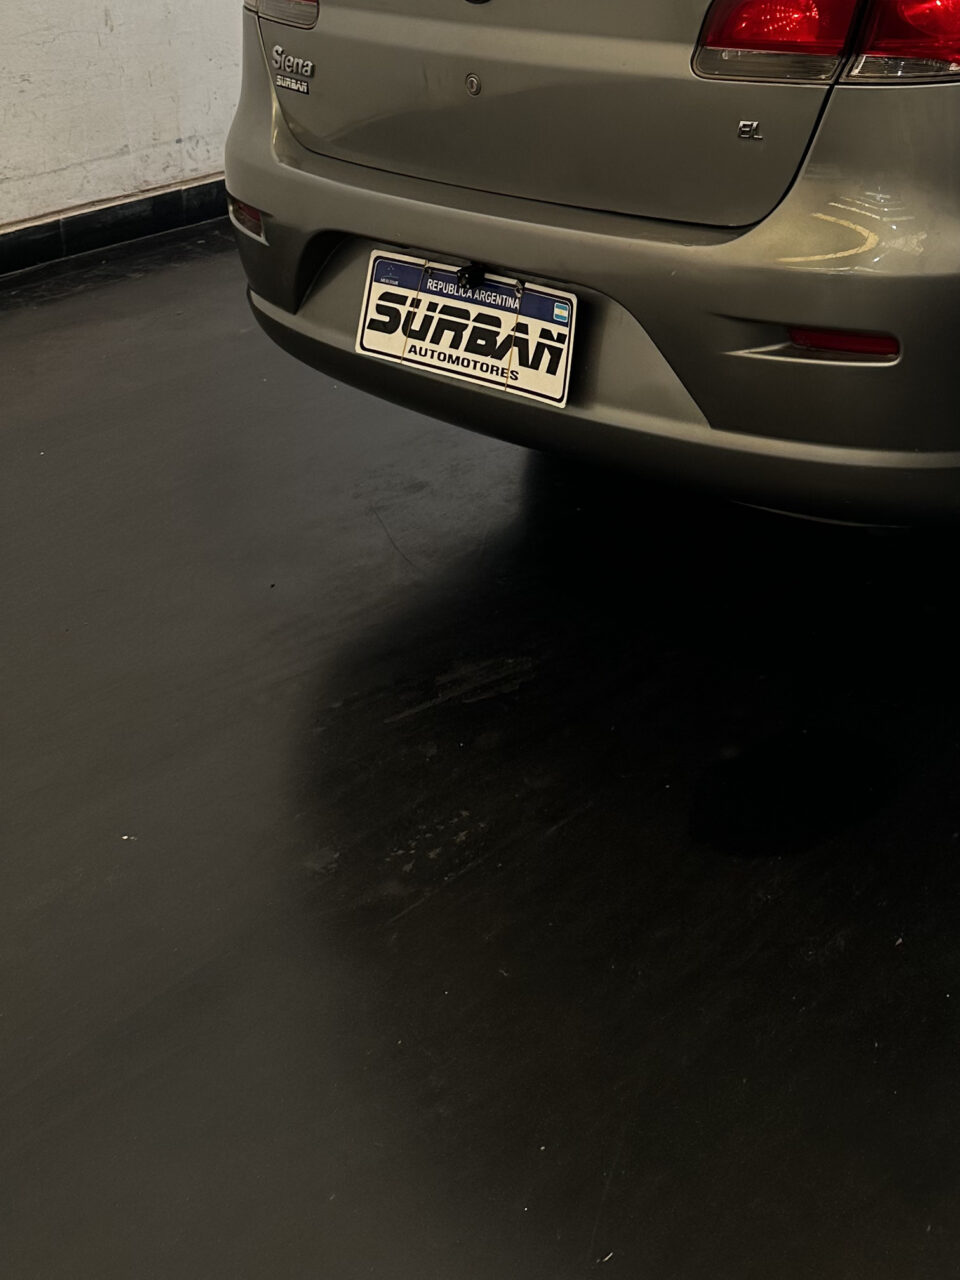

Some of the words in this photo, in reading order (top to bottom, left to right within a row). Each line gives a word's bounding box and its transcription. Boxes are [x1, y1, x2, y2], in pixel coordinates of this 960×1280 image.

[272, 45, 313, 76] Siena
[738, 120, 763, 139] EL
[426, 278, 473, 299] REPUBLICA
[473, 289, 519, 310] ARGENTINA
[366, 291, 568, 377] SURBAN
[408, 344, 520, 381] AUTOMOTORES
